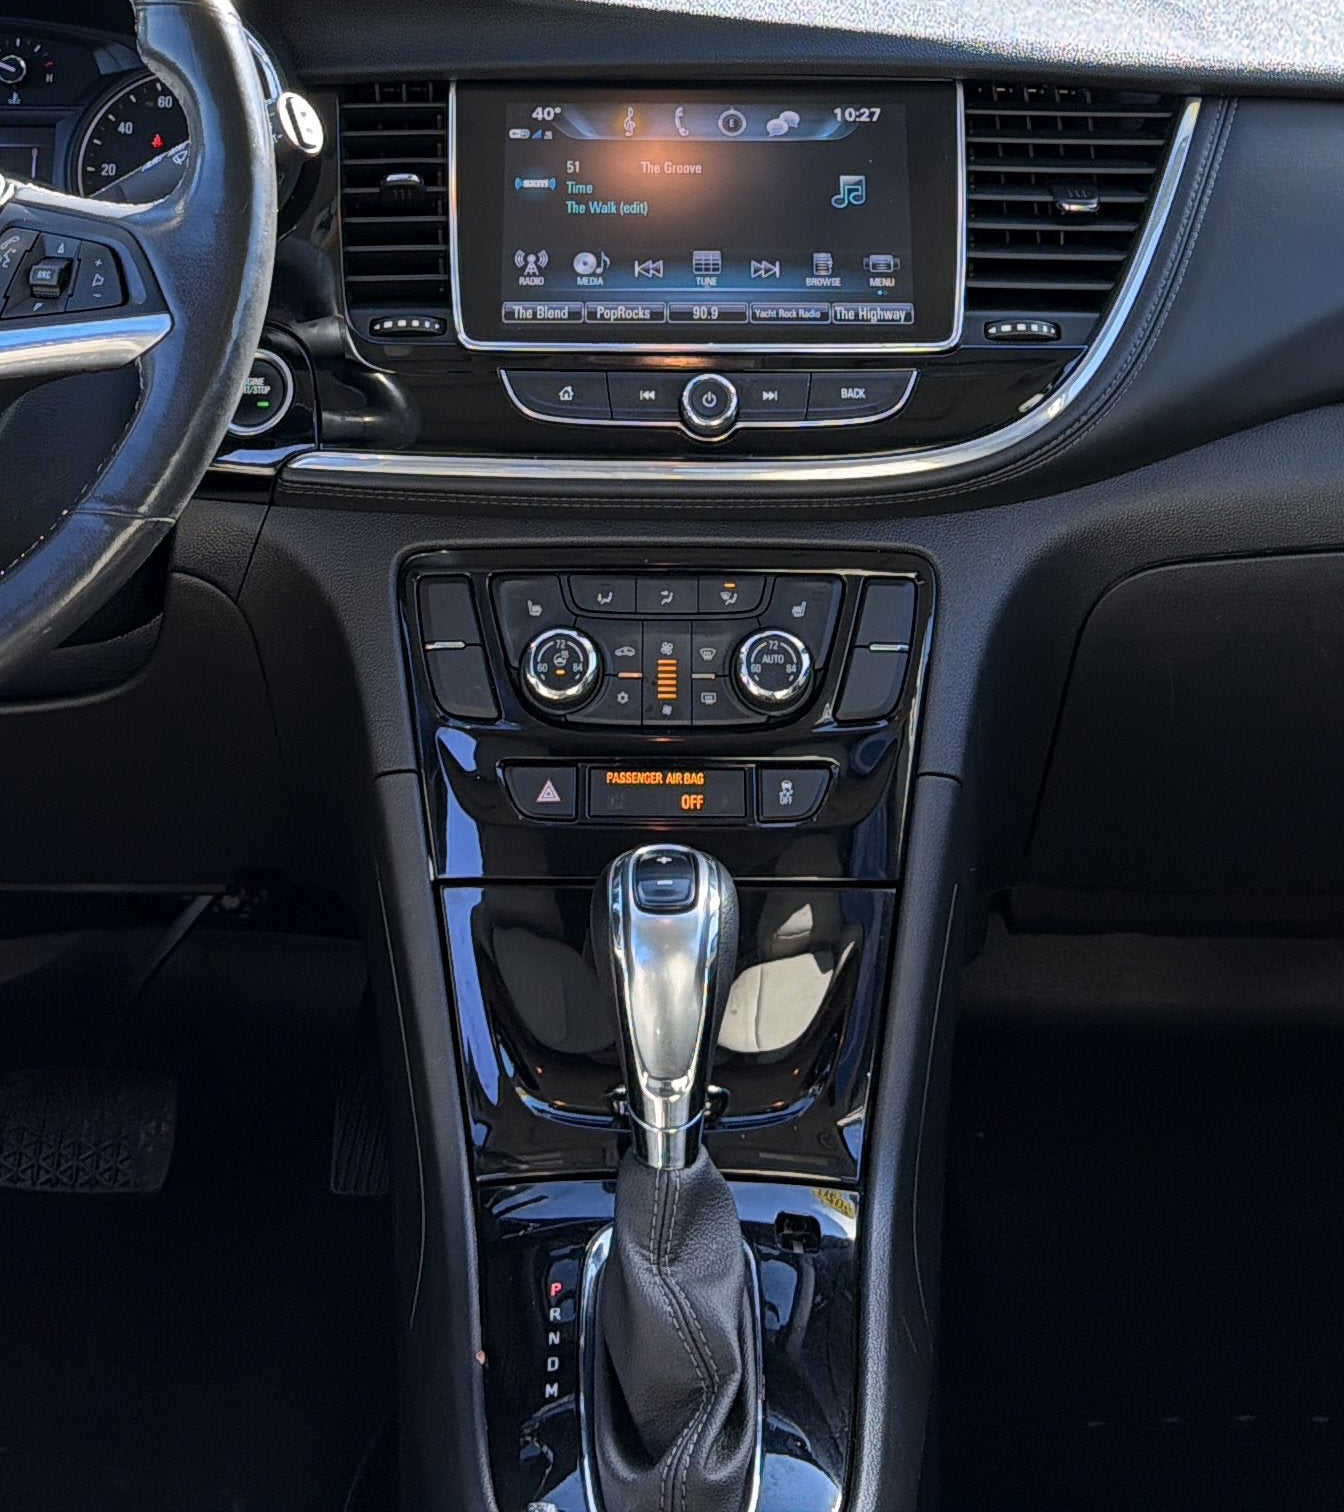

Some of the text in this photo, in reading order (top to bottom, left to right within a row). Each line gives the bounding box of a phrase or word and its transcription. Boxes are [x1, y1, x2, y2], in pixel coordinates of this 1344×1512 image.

[45, 73, 54, 83] H
[158, 96, 172, 108] 60
[532, 107, 562, 121] 40°
[833, 108, 881, 122] 10:27
[117, 121, 133, 134] 40
[101, 163, 116, 176] 20
[566, 160, 580, 173] 51
[641, 161, 702, 174] The Groove
[566, 181, 593, 194] Time
[566, 201, 648, 216] The Walk (edit)
[518, 277, 545, 286] RADIO
[576, 277, 604, 286] MEDIA
[696, 277, 718, 286] TUNE
[806, 278, 841, 287] BROWSE
[869, 278, 895, 287] MENU
[513, 306, 568, 319] The Blend
[597, 306, 650, 322] PopRocks
[692, 306, 718, 319] 90.9
[755, 309, 821, 318] Yacht Rock Radio
[835, 306, 906, 323] The Highway
[841, 388, 866, 399] BACK
[556, 639, 566, 649] 72
[768, 640, 779, 650] 72
[762, 654, 784, 664] AUTO
[537, 663, 548, 673] 60
[572, 662, 583, 672] 84
[751, 664, 761, 674] 60
[786, 664, 796, 674] 84
[606, 772, 704, 784] PASSENGER AIR BAG
[681, 794, 704, 810] OFF
[551, 1282, 562, 1296] P
[549, 1308, 561, 1321] R
[548, 1331, 560, 1346] N
[547, 1356, 559, 1372] D
[545, 1382, 558, 1398] M
